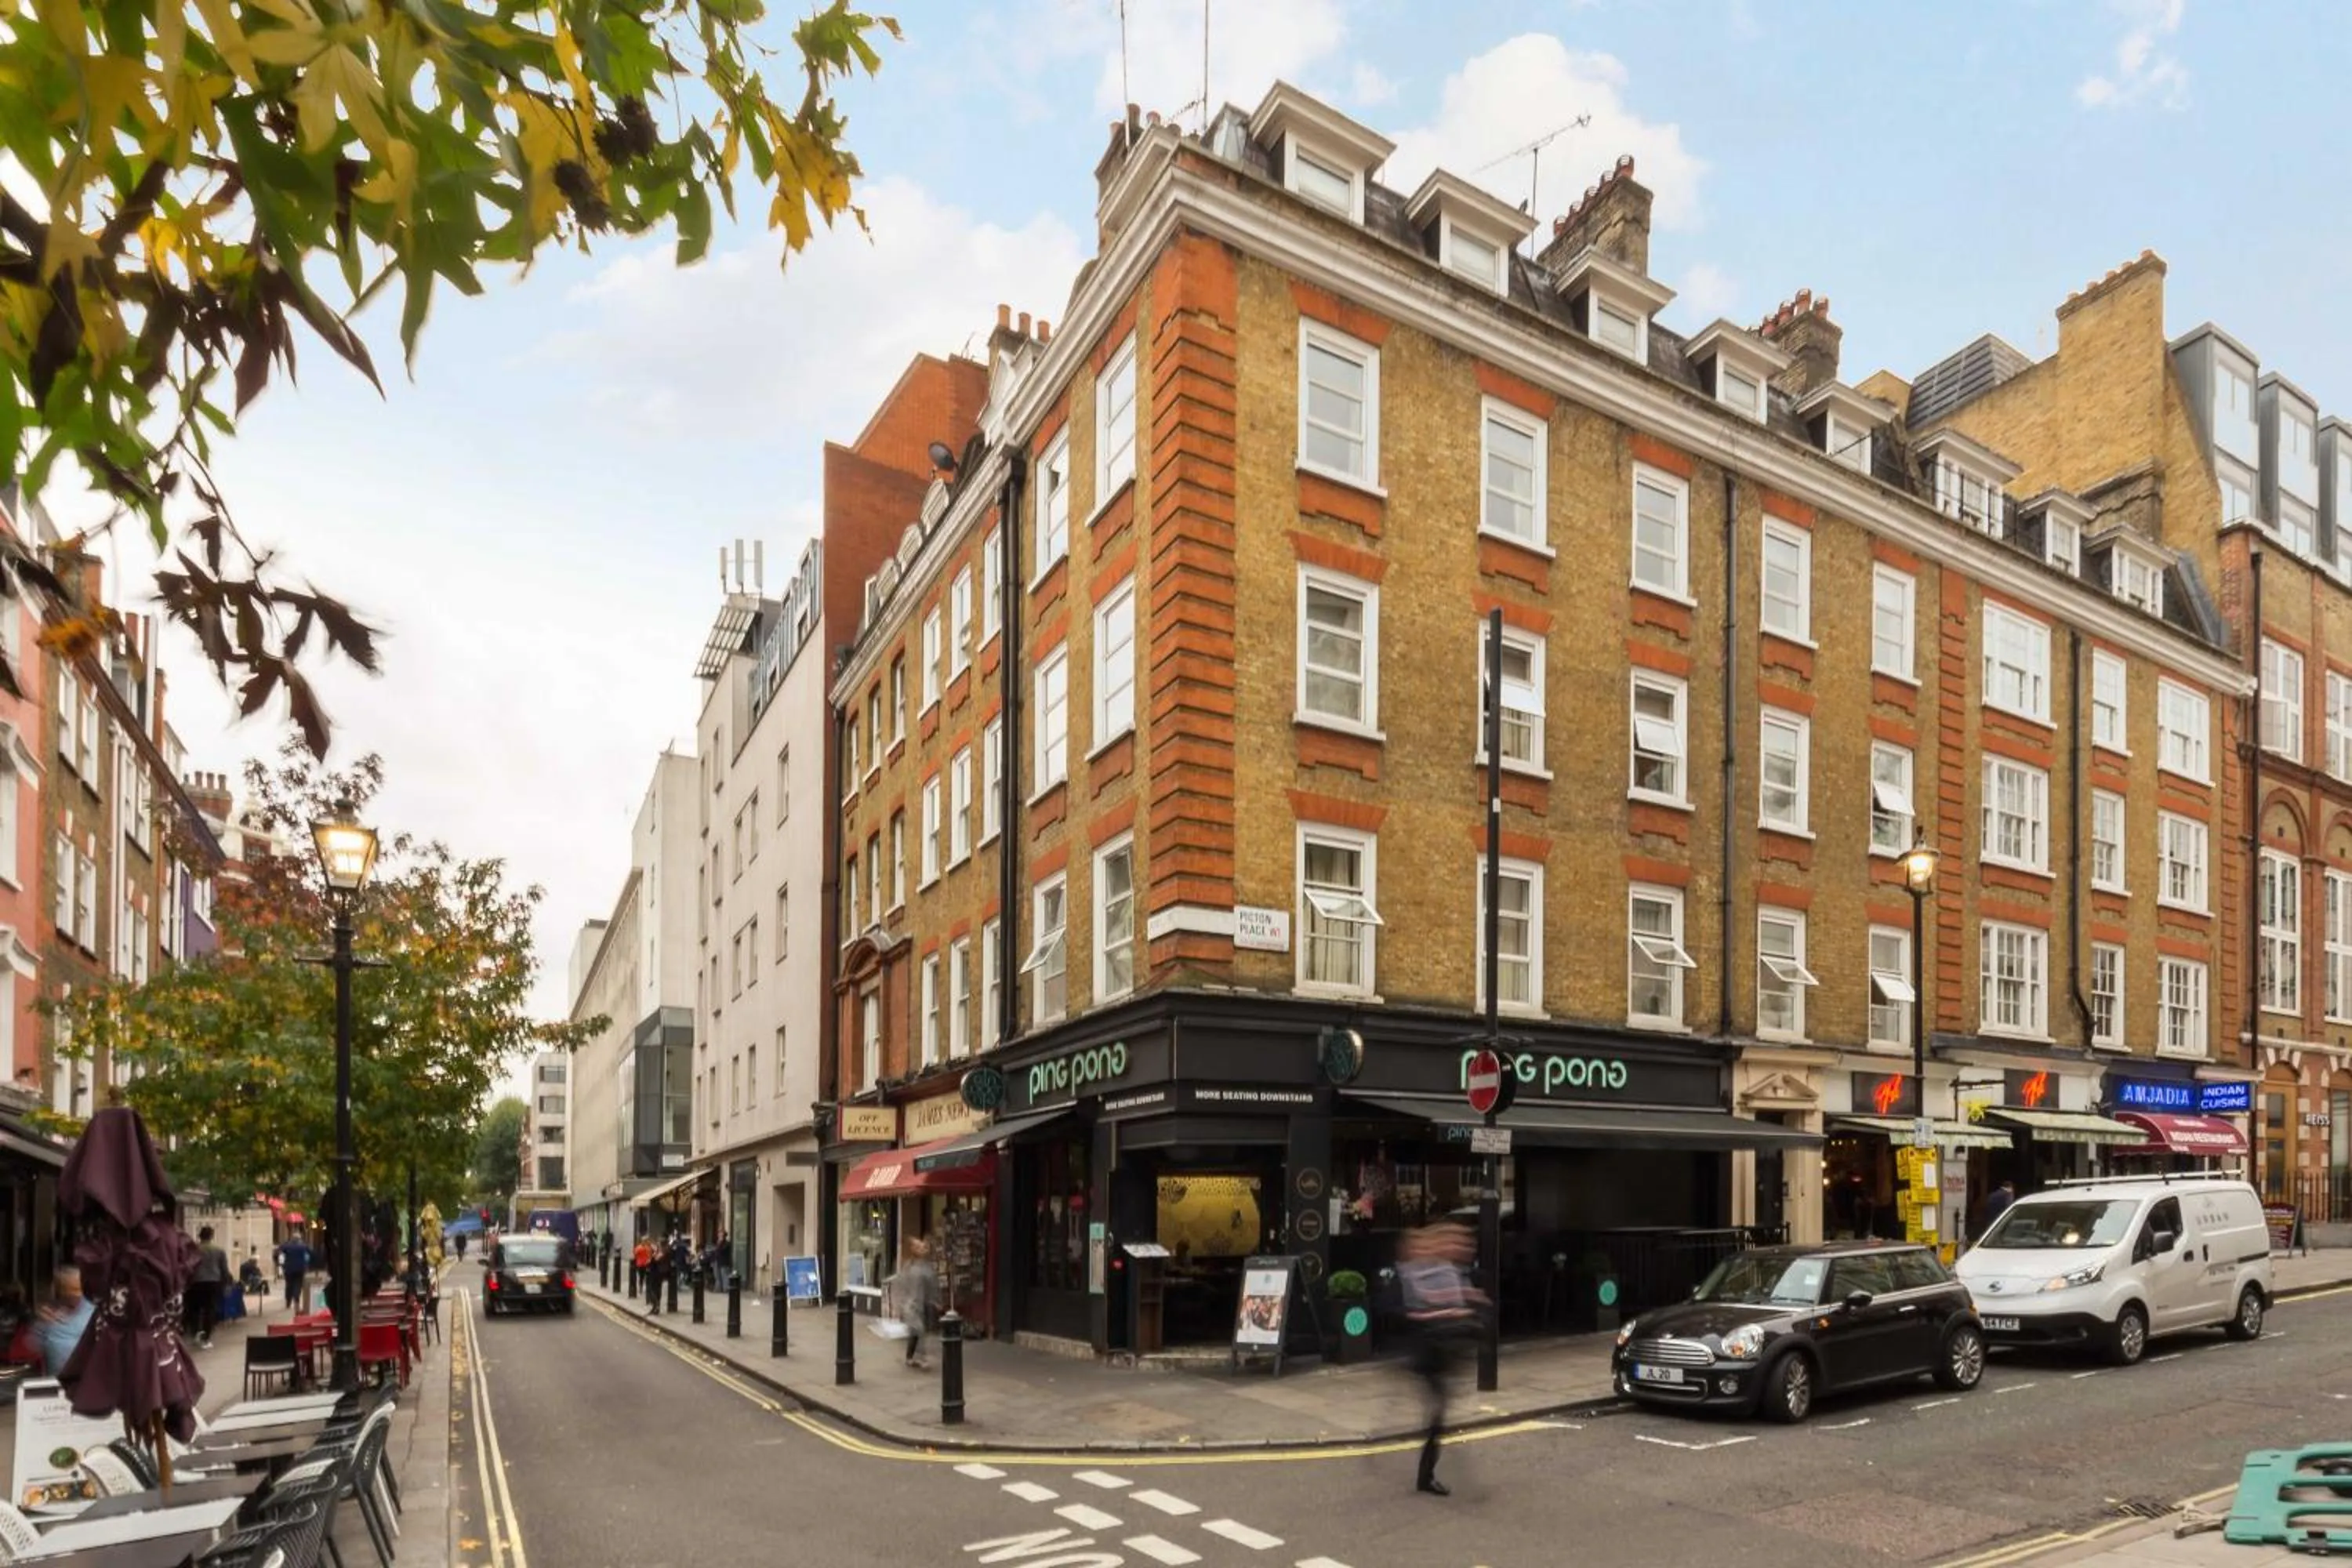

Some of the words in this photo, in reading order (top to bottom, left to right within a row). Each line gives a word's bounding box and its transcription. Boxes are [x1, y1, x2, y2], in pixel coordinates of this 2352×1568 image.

[1240, 910, 1272, 925] PICTON
[1240, 924, 1265, 935] PLACE
[1269, 927, 1280, 938] W1
[1195, 1091, 1221, 1100] MORE
[1222, 1091, 1258, 1101] SEATING
[1260, 1092, 1313, 1103] DOWNSTAIRS
[2124, 1083, 2190, 1105] AMJADIA
[2203, 1085, 2245, 1097] INDIAN
[2201, 1098, 2247, 1109] CUISINE
[858, 1113, 879, 1123] OFF
[916, 1105, 942, 1128] JAMES
[2306, 1113, 2330, 1126] REISS
[847, 1123, 891, 1134] LICENCE
